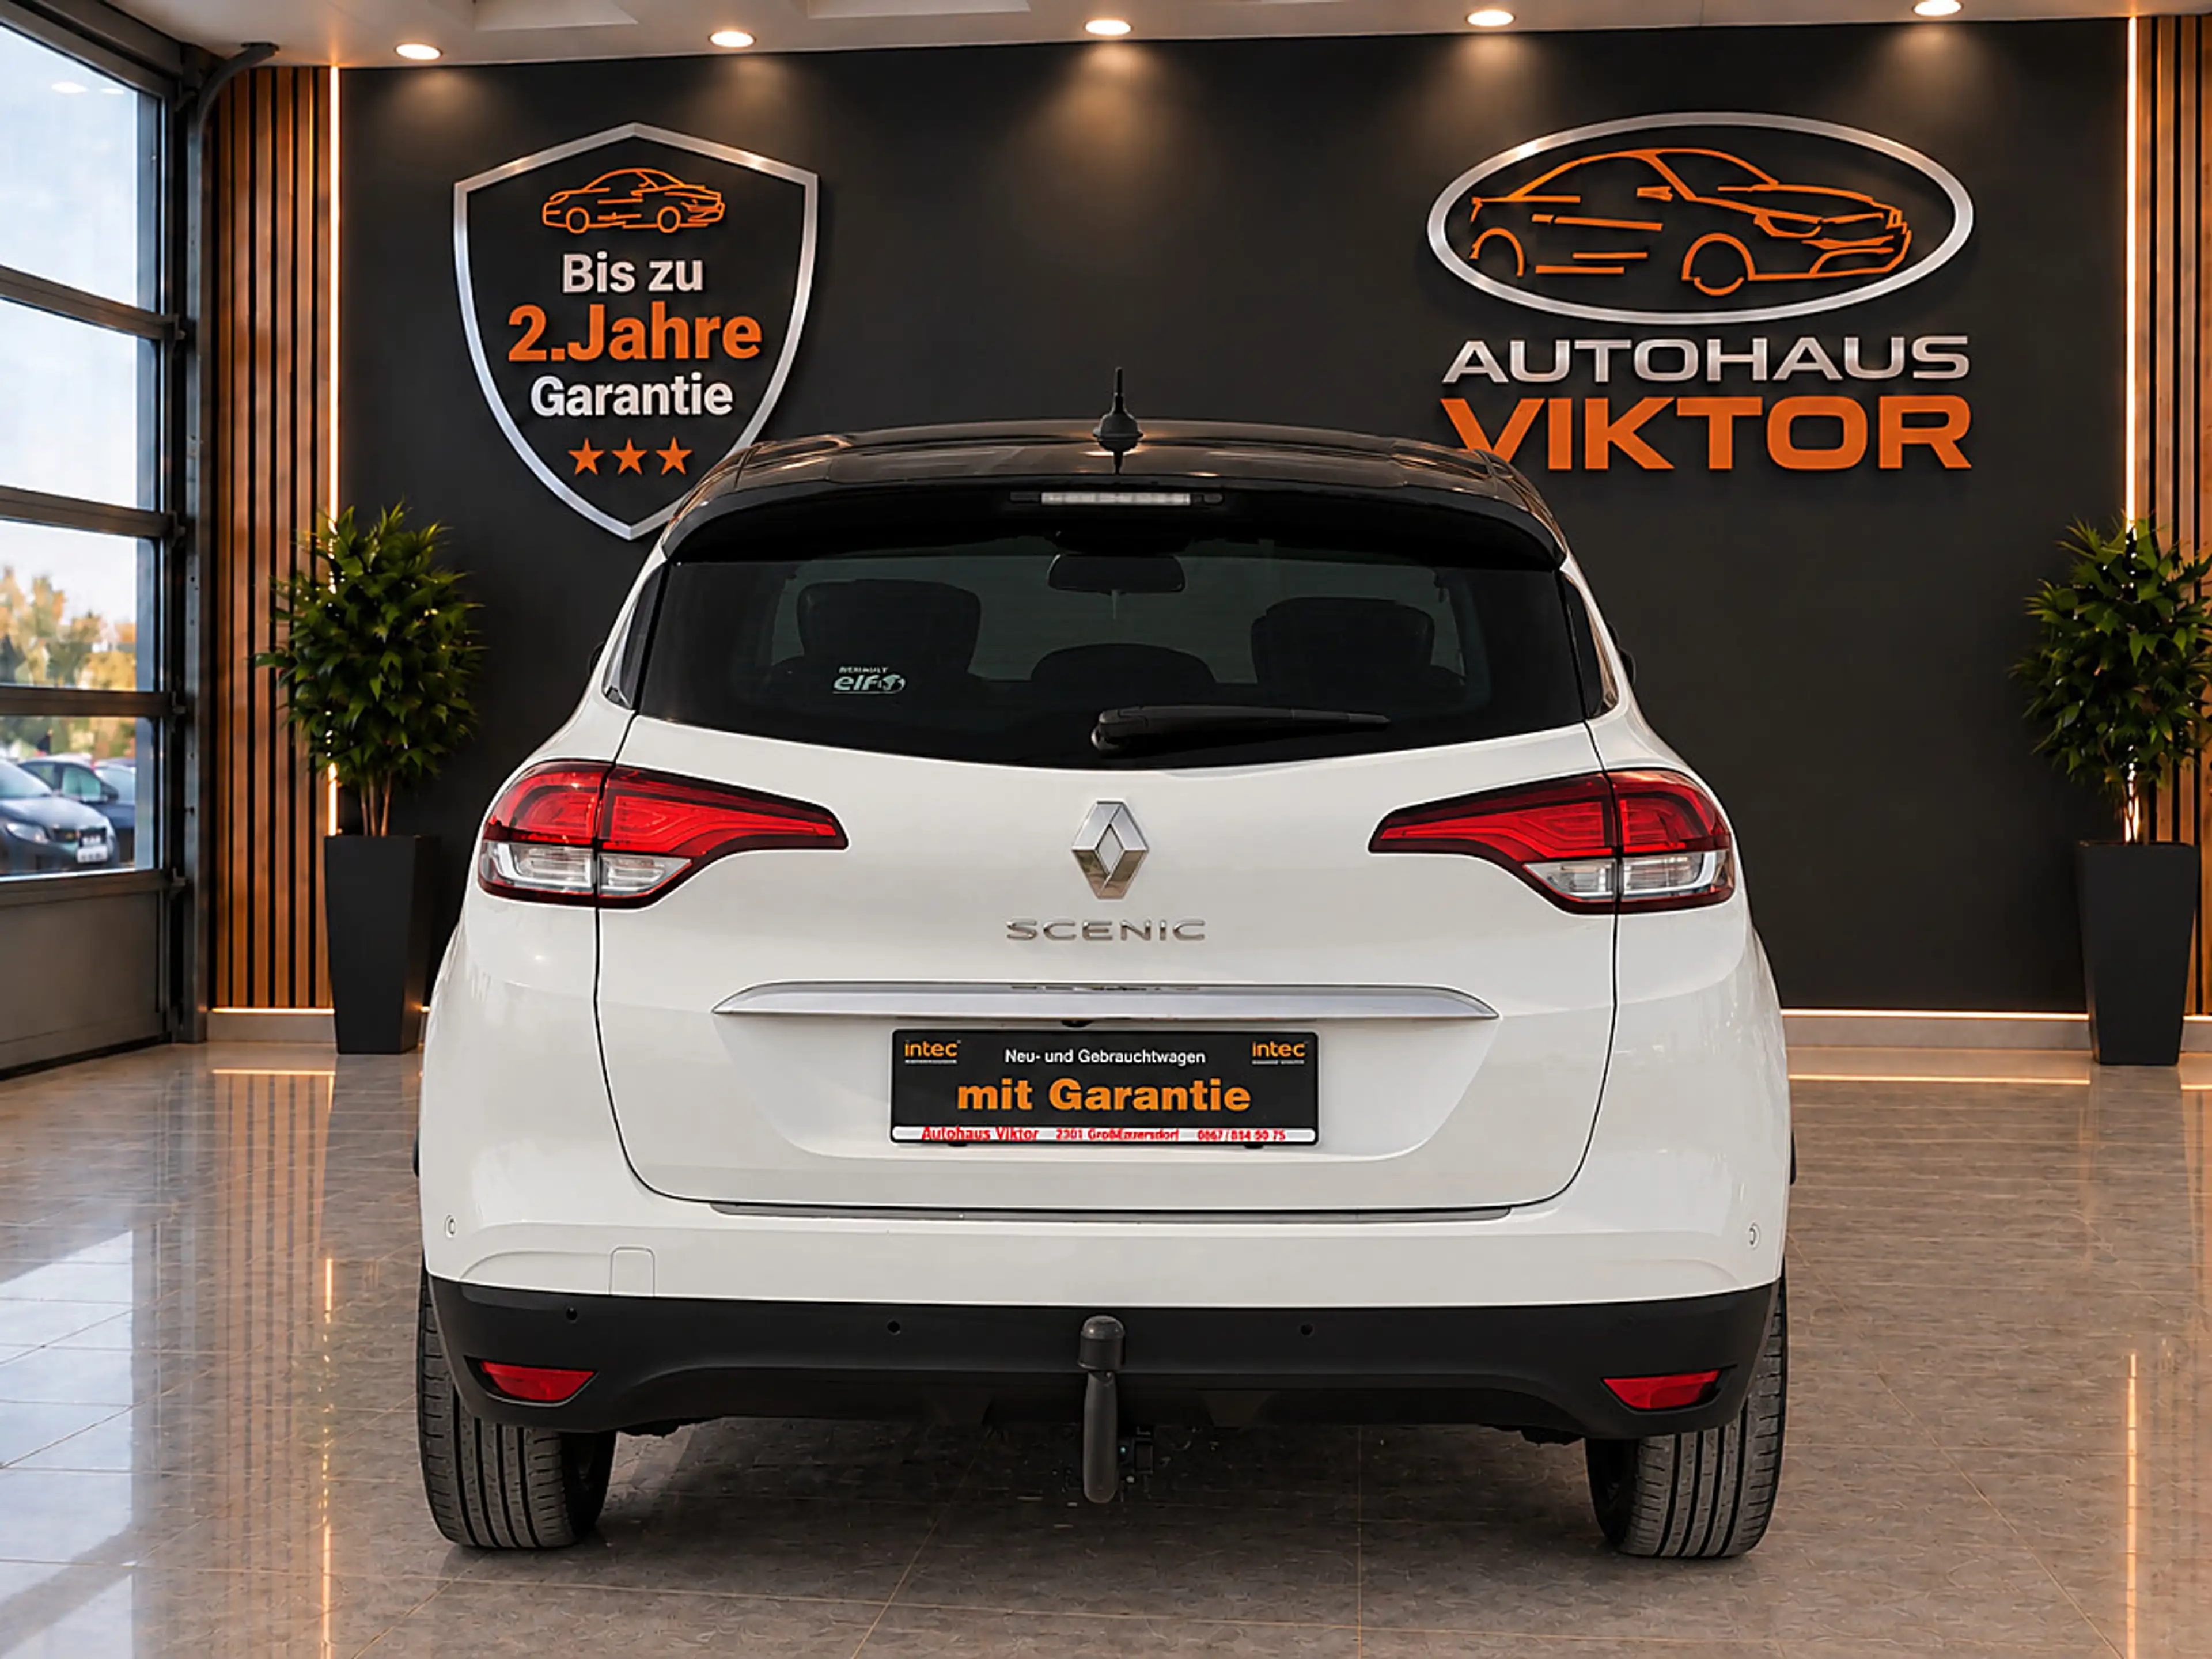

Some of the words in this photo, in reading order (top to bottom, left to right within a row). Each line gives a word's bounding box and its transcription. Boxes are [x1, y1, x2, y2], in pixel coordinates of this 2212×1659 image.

[562, 250, 637, 294] Bis
[647, 259, 703, 293] zu
[508, 300, 763, 362] 2.Jahre
[1441, 335, 1970, 384] AUTOHAUS
[530, 371, 734, 418] Garantie
[1440, 395, 1972, 471] VIKTOR
[1006, 918, 1206, 942] SCENIC
[904, 1040, 958, 1058] intec
[1005, 1048, 1041, 1063] Neu-
[1044, 1048, 1074, 1063] und
[1077, 1048, 1206, 1067] Gebrauchtwagen
[1252, 1040, 1306, 1058] intec
[957, 1077, 1033, 1112] mit
[1048, 1077, 1251, 1112] Garantie
[921, 1126, 991, 1142] Autohaus
[995, 1126, 1039, 1142] Viktor
